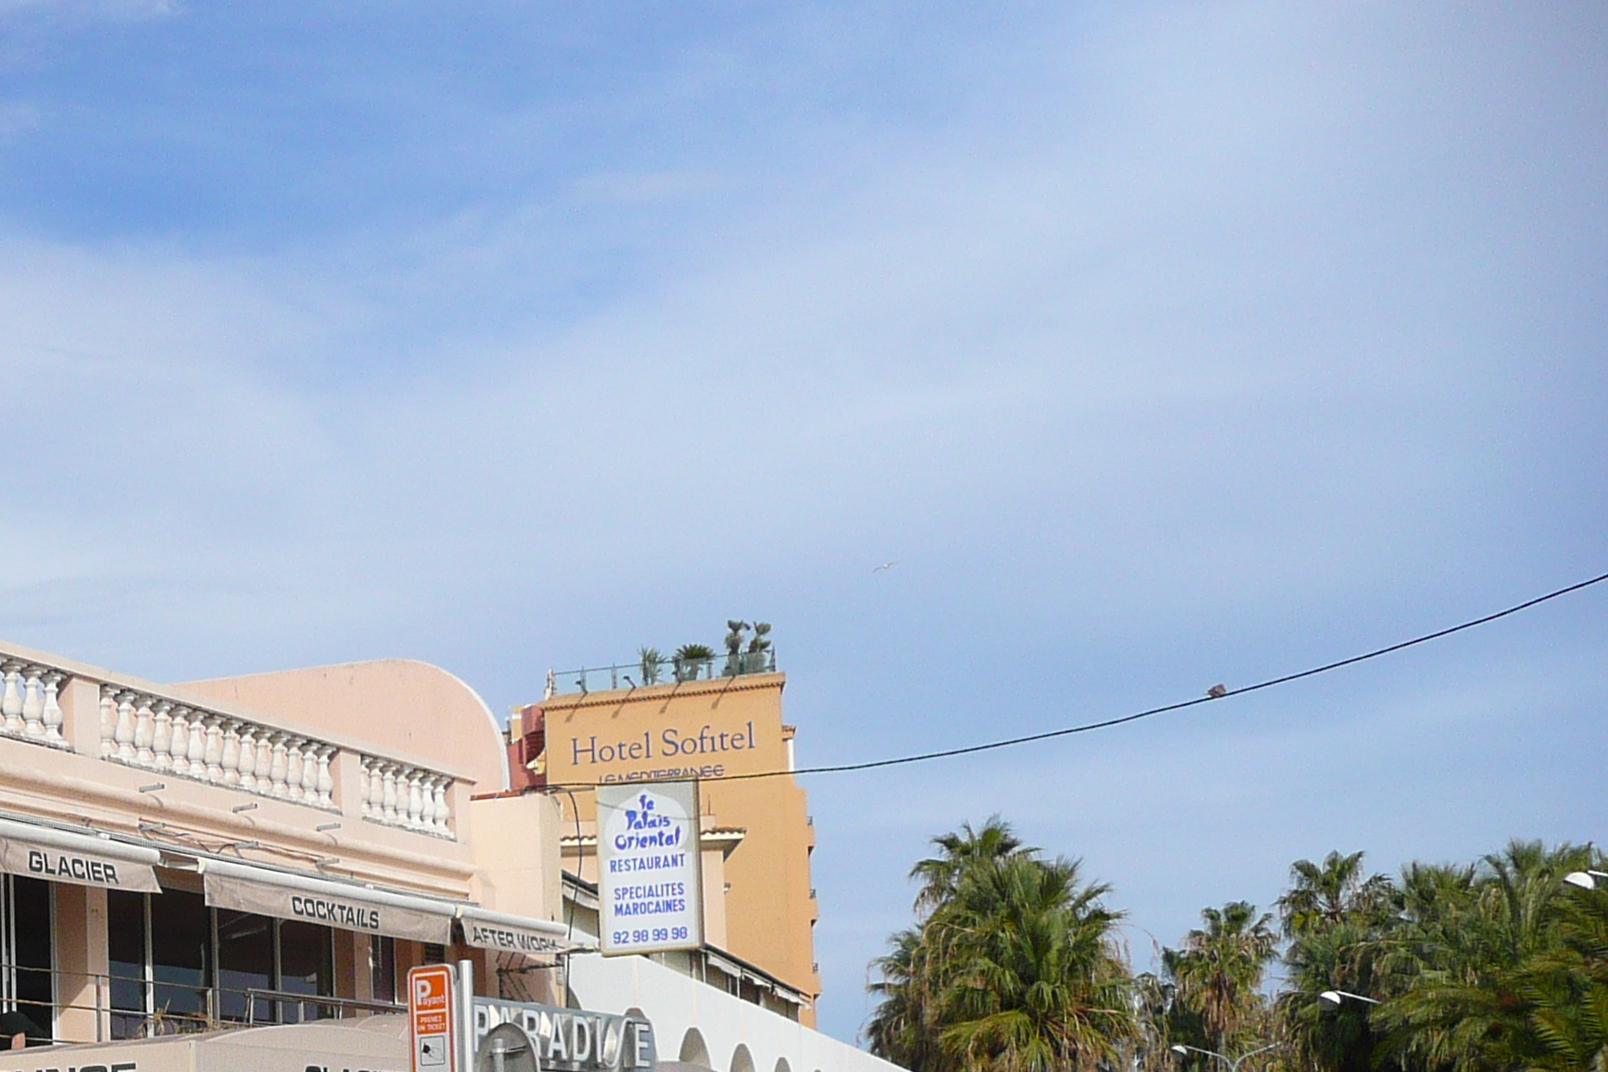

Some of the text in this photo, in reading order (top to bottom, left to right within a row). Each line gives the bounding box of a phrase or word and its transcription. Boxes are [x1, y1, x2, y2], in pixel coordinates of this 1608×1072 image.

[571, 721, 756, 766] Hotel Sofitel
[625, 810, 671, 831] Palais
[615, 825, 682, 851] Oriental
[28, 850, 120, 885] GLACIER
[610, 853, 686, 874] RESTAURANT
[614, 882, 685, 901] SPECIALITES
[292, 896, 380, 930] COCKTAILS
[614, 899, 686, 917] MAROCAINES
[473, 926, 517, 949] AFTER
[612, 926, 688, 945] 92 98 99 98
